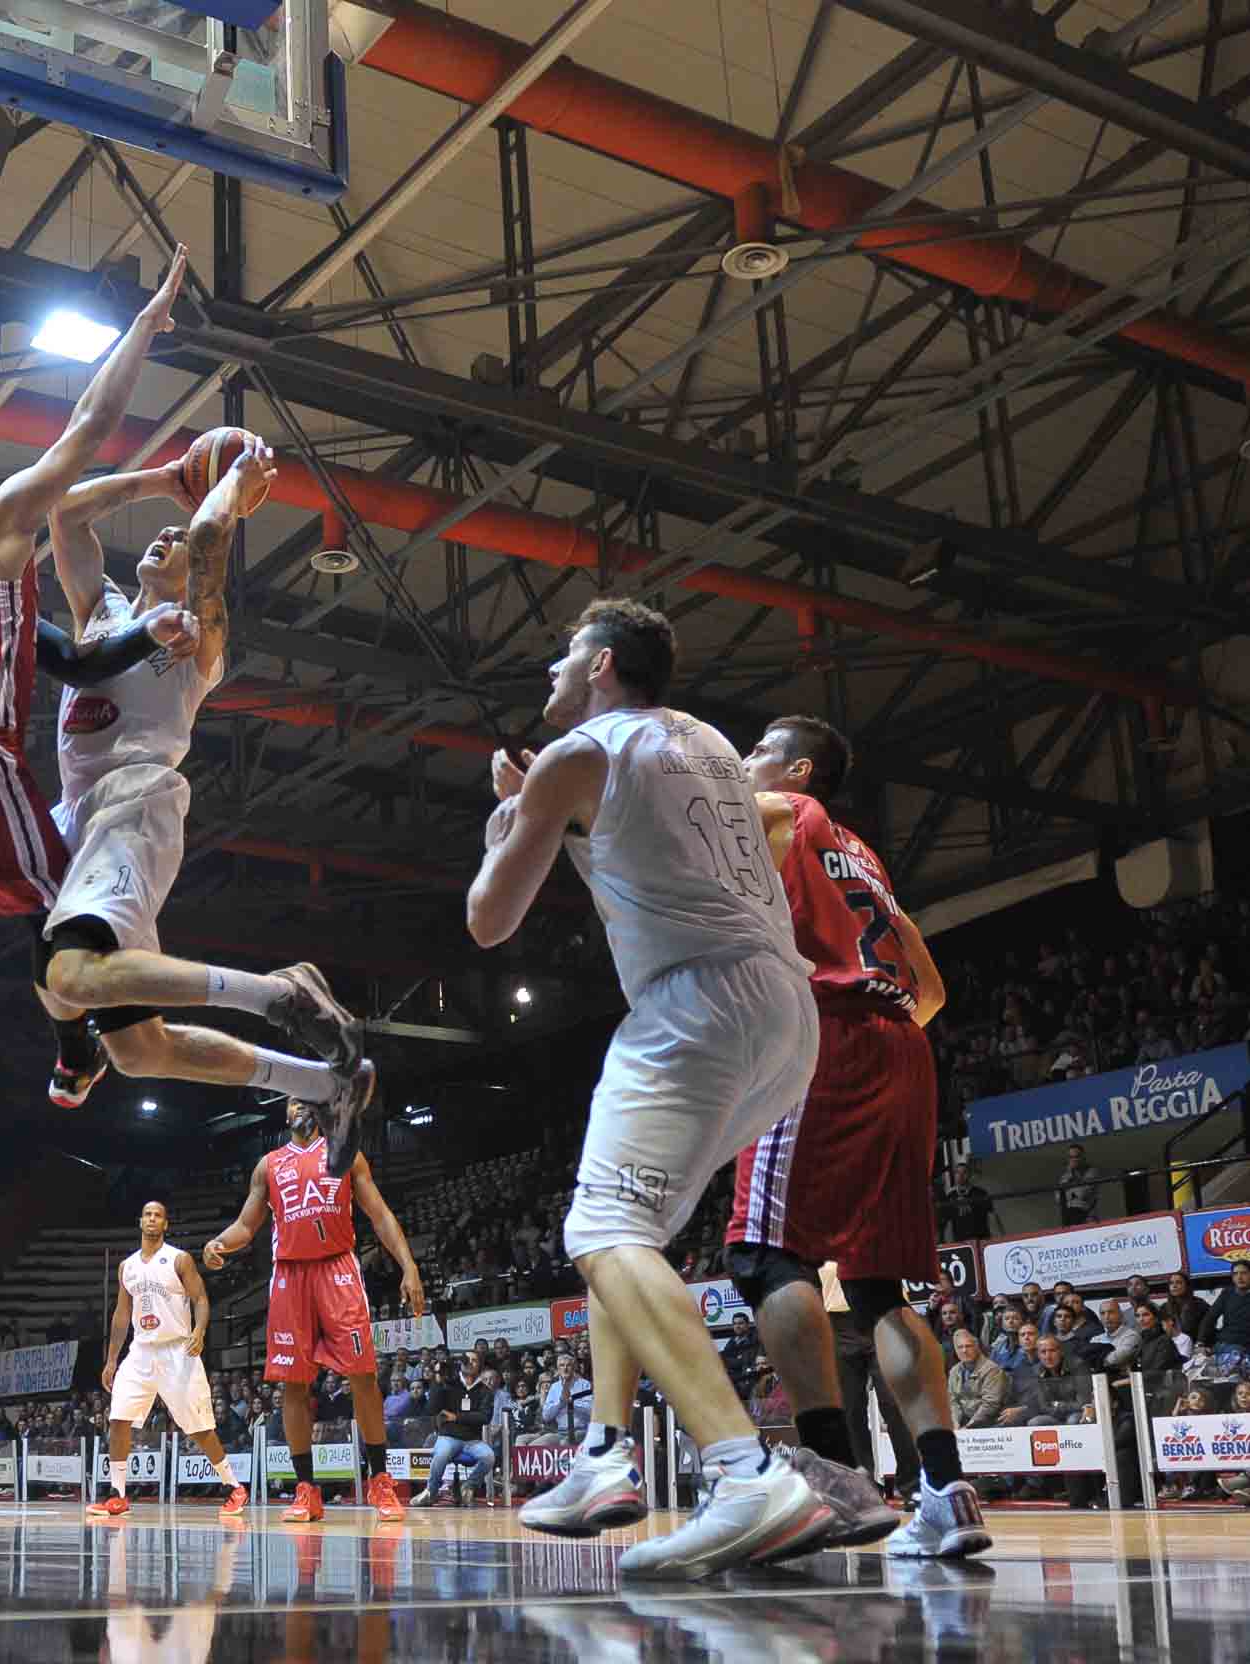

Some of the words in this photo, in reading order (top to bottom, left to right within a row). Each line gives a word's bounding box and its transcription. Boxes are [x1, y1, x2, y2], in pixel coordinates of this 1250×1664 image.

[686, 797, 774, 906] 13
[112, 865, 131, 897] 1
[1131, 1064, 1203, 1100] Pasta
[988, 1108, 1104, 1153] TRIBUNA
[1110, 1077, 1224, 1132] REGGIA
[280, 1177, 343, 1214] EA7
[616, 1163, 669, 1213] 13
[313, 1216, 326, 1242] 1
[1038, 1242, 1099, 1262] PATRONATO
[1108, 1238, 1129, 1251] CAF
[350, 1331, 363, 1356] 1
[1161, 1442, 1206, 1457] BERNA
